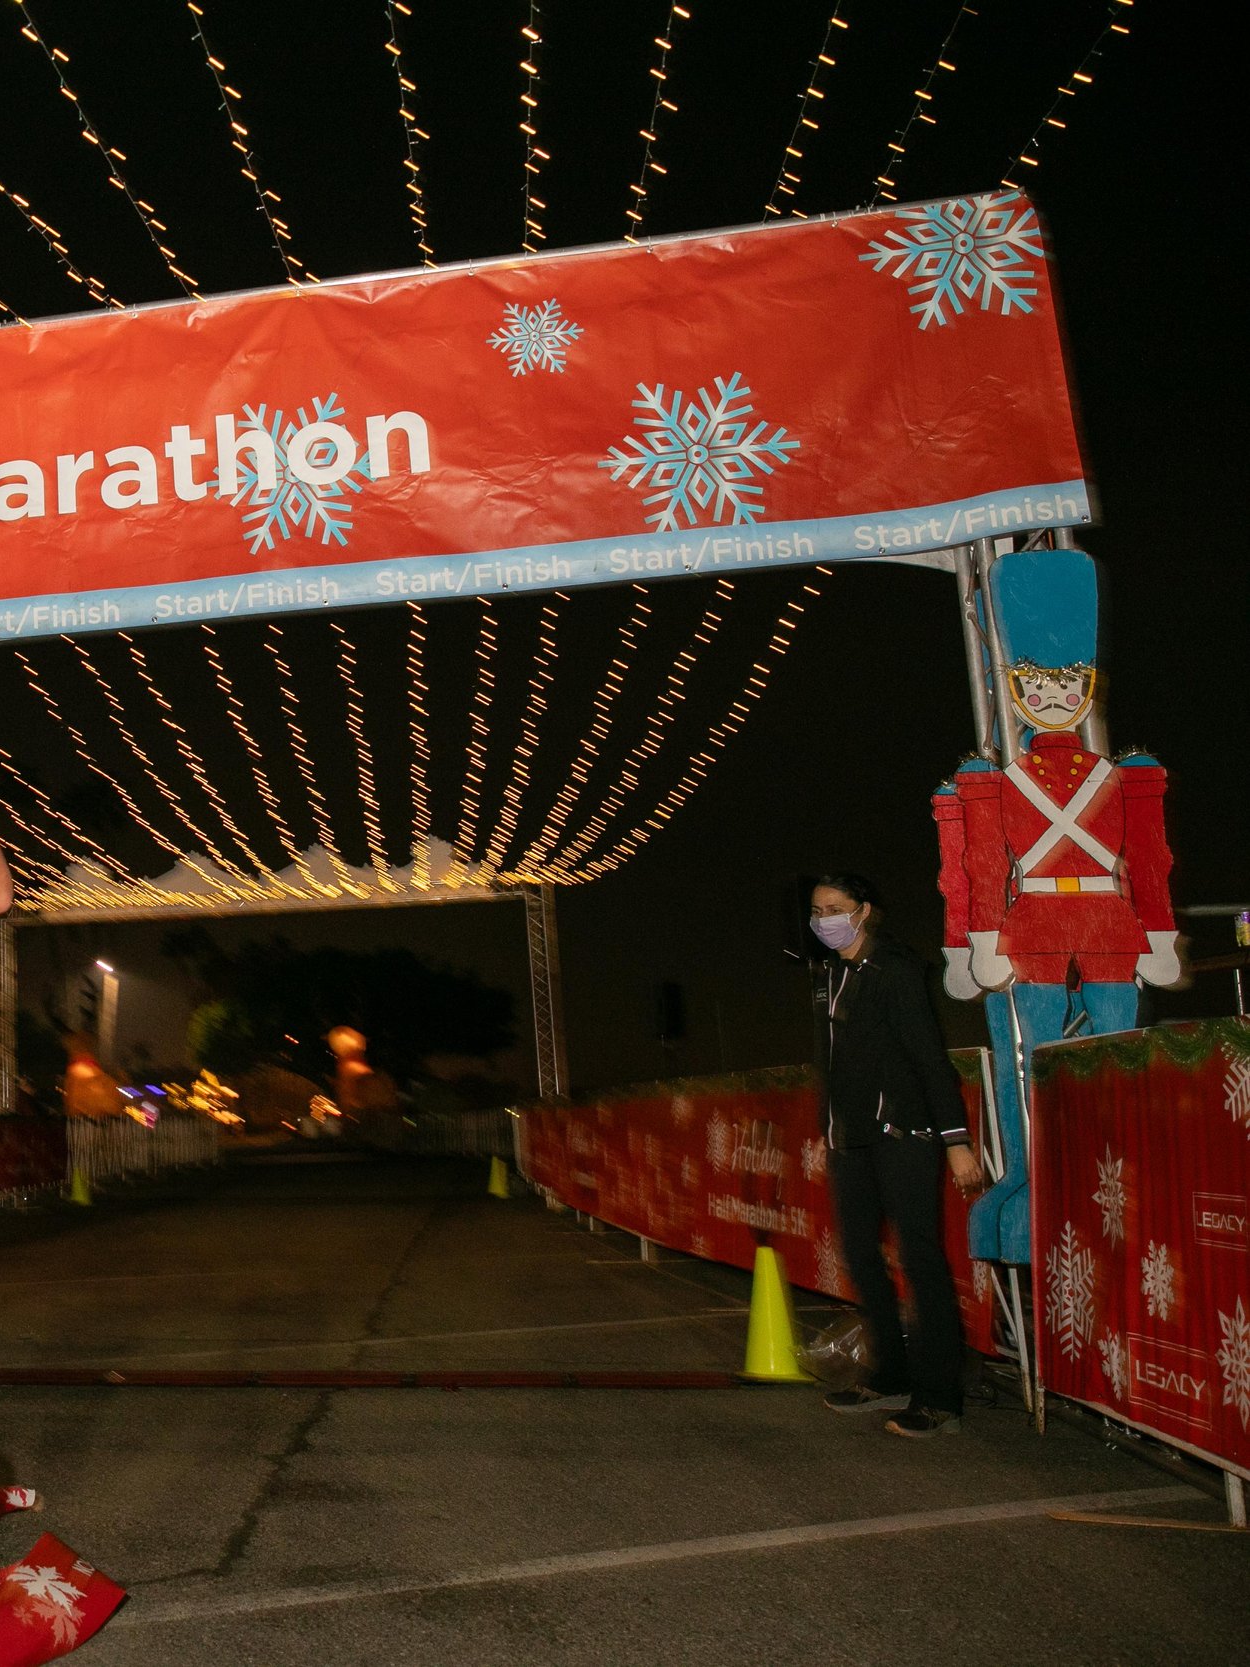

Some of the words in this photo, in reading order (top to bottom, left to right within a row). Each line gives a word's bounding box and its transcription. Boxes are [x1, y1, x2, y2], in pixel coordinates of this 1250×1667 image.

[154, 576, 339, 613] Start/Finish
[376, 555, 570, 596] Start/Finish
[609, 532, 814, 575] Start/Finish
[854, 494, 1078, 551] Start/Finish
[791, 1206, 807, 1237] 5K
[1196, 1210, 1245, 1232] LEGACY
[1135, 1359, 1206, 1400] LEGACY
